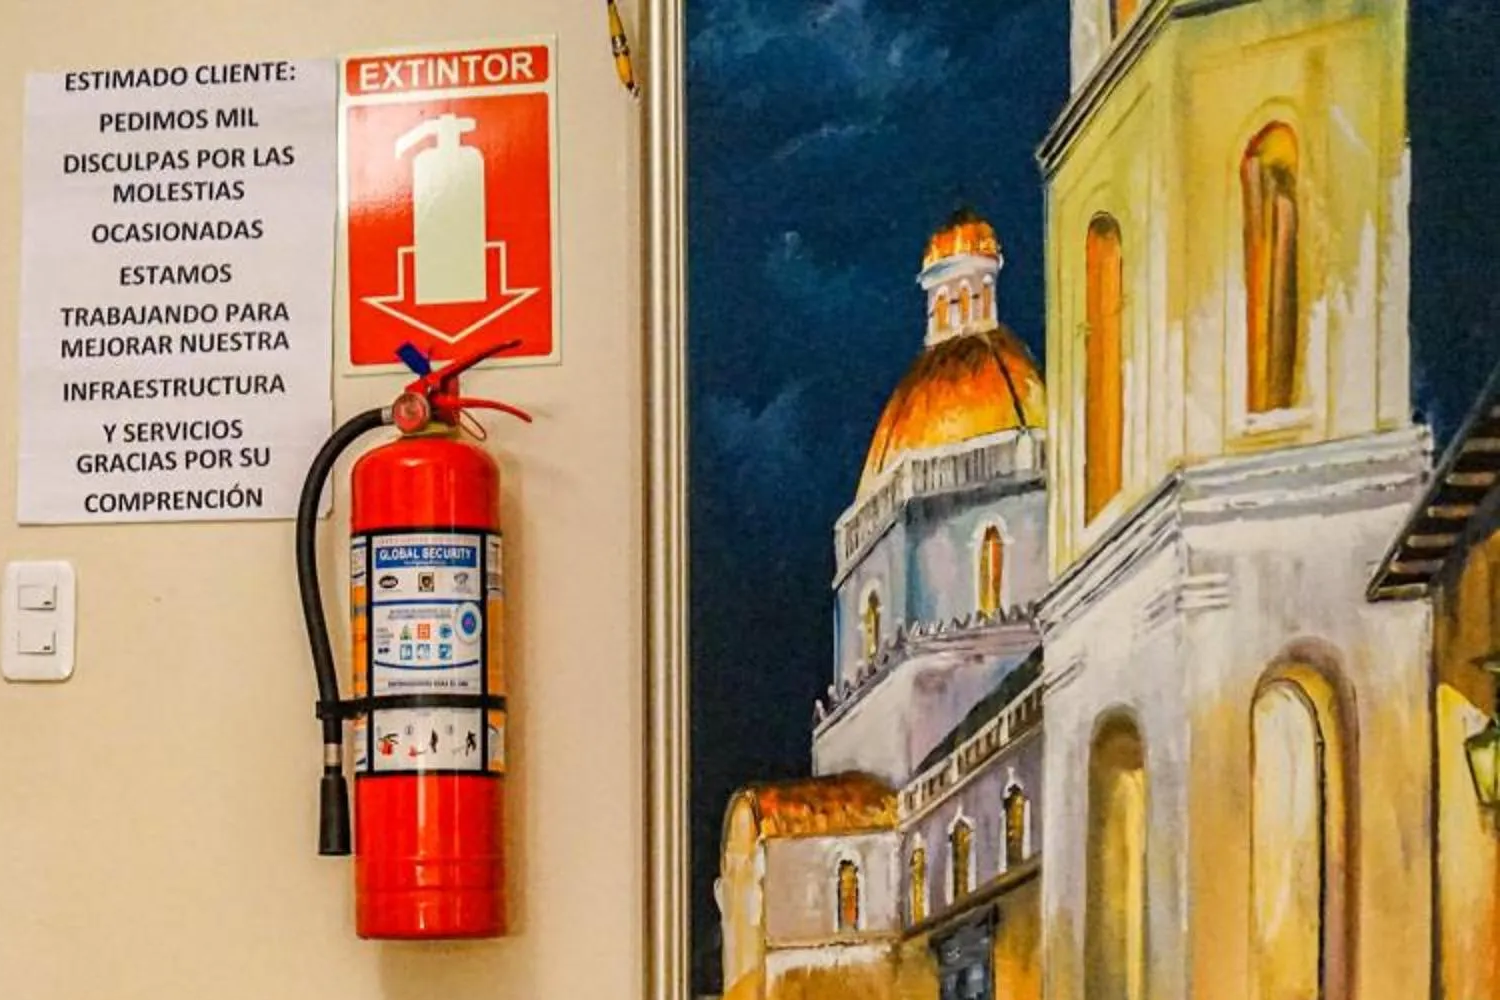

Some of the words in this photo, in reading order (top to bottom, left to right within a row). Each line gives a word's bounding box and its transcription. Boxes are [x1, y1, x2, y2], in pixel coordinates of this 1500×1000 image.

[65, 66, 189, 92] ESTIMADO
[195, 61, 296, 85] CLIENTE:
[359, 53, 534, 91] EXTINTOR
[99, 108, 209, 133] PEDIMOS
[215, 107, 259, 129] MIL
[63, 149, 190, 175] DISCULPAS
[197, 148, 245, 169] POR
[253, 145, 295, 167] LAS
[113, 180, 245, 204] MOLESTIAS
[91, 219, 264, 244] OCASIONADAS
[119, 263, 232, 286] ESTAMOS
[60, 303, 219, 327] TRABAJANDO
[225, 302, 290, 323] PARA
[61, 335, 173, 359] MEJORAR
[180, 330, 290, 353] NUESTRA
[63, 373, 286, 402] INFRAESTRUCTURA
[103, 423, 117, 444] Y
[123, 419, 243, 443] SERVICIOS
[76, 450, 178, 474] GRACIAS
[184, 448, 233, 470] POR
[239, 447, 271, 468] SU
[83, 483, 263, 513] COMPRENCIÓN
[379, 548, 420, 561] GLOBAL
[422, 547, 471, 560] SECURITY
